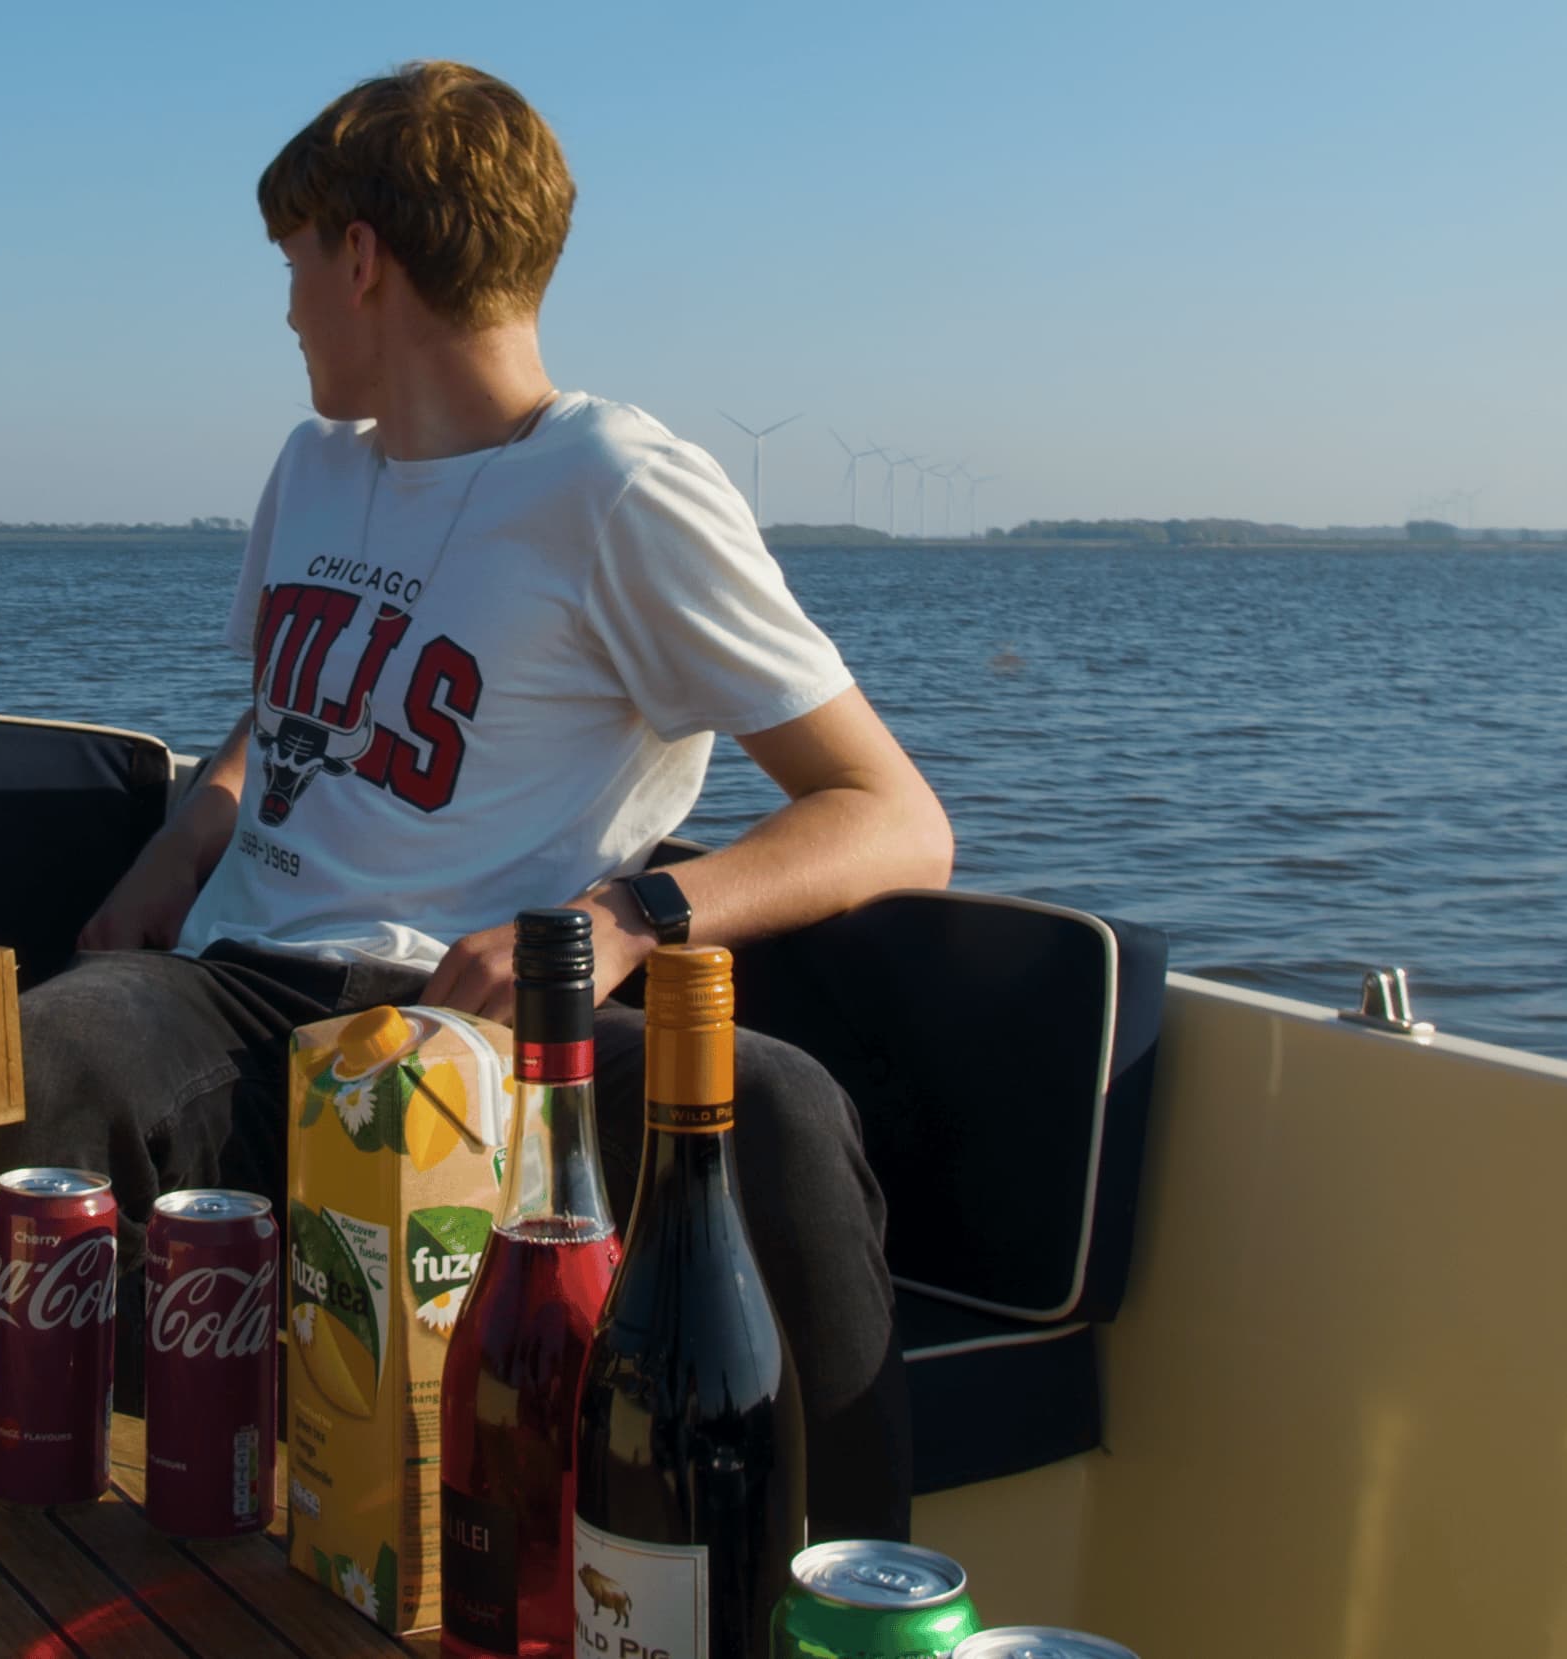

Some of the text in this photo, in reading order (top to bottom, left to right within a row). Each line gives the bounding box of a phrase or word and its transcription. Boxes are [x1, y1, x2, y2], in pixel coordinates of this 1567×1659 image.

[307, 555, 423, 604] CHICAGO
[253, 583, 484, 813] ULLS
[669, 1107, 711, 1121] WILD
[13, 1231, 62, 1249] Cherry
[359, 1243, 388, 1263] fusion
[406, 1378, 440, 1392] green
